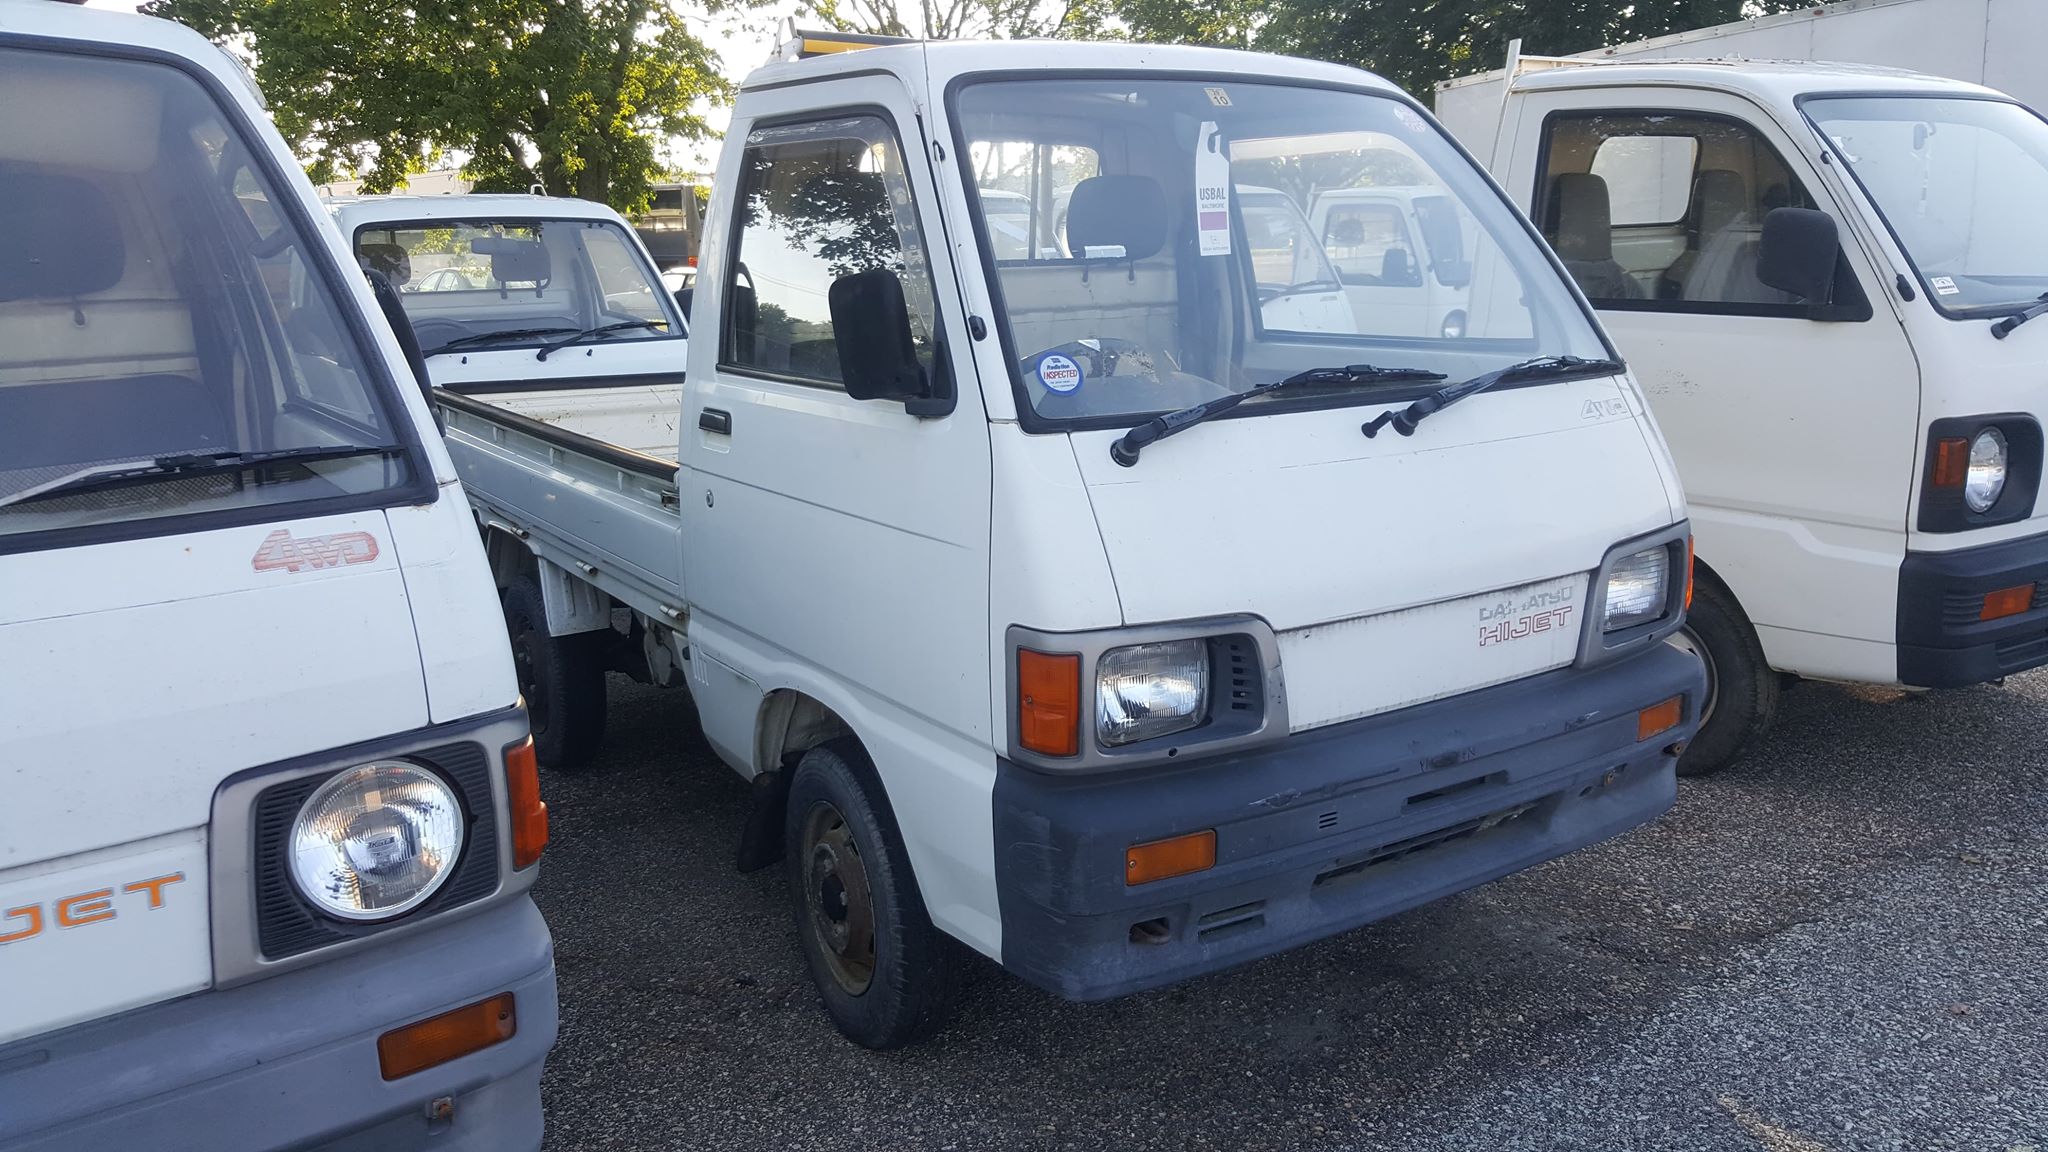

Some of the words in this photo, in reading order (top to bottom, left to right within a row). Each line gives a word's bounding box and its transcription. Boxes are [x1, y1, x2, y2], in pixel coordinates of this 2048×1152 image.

[1199, 187, 1226, 200] USBAL
[1043, 369, 1078, 380] INSPECTED
[251, 528, 379, 574] 4WD
[1479, 605, 1573, 647] HIJET
[0, 871, 186, 945] JET
